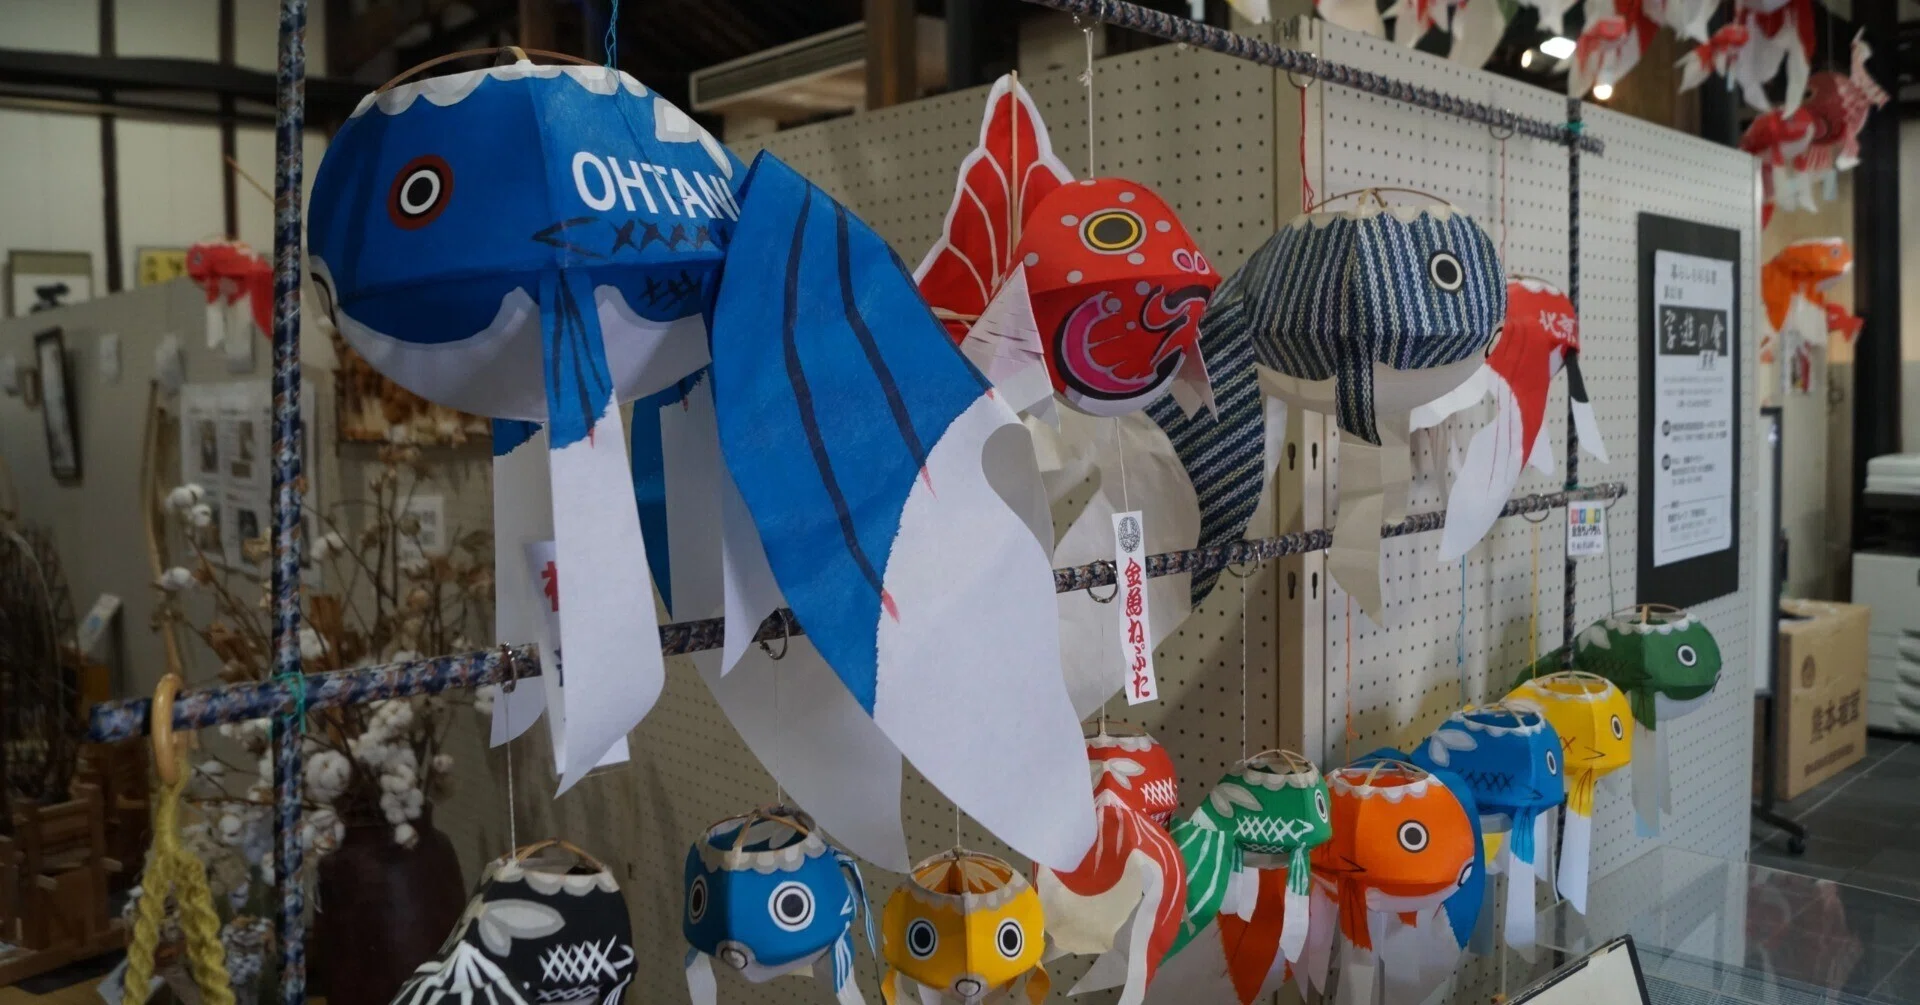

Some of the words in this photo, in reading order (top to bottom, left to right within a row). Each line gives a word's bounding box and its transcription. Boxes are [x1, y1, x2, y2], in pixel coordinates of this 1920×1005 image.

[572, 151, 741, 222] OHTANI
[1124, 557, 1150, 698] 金魚ねぷた
